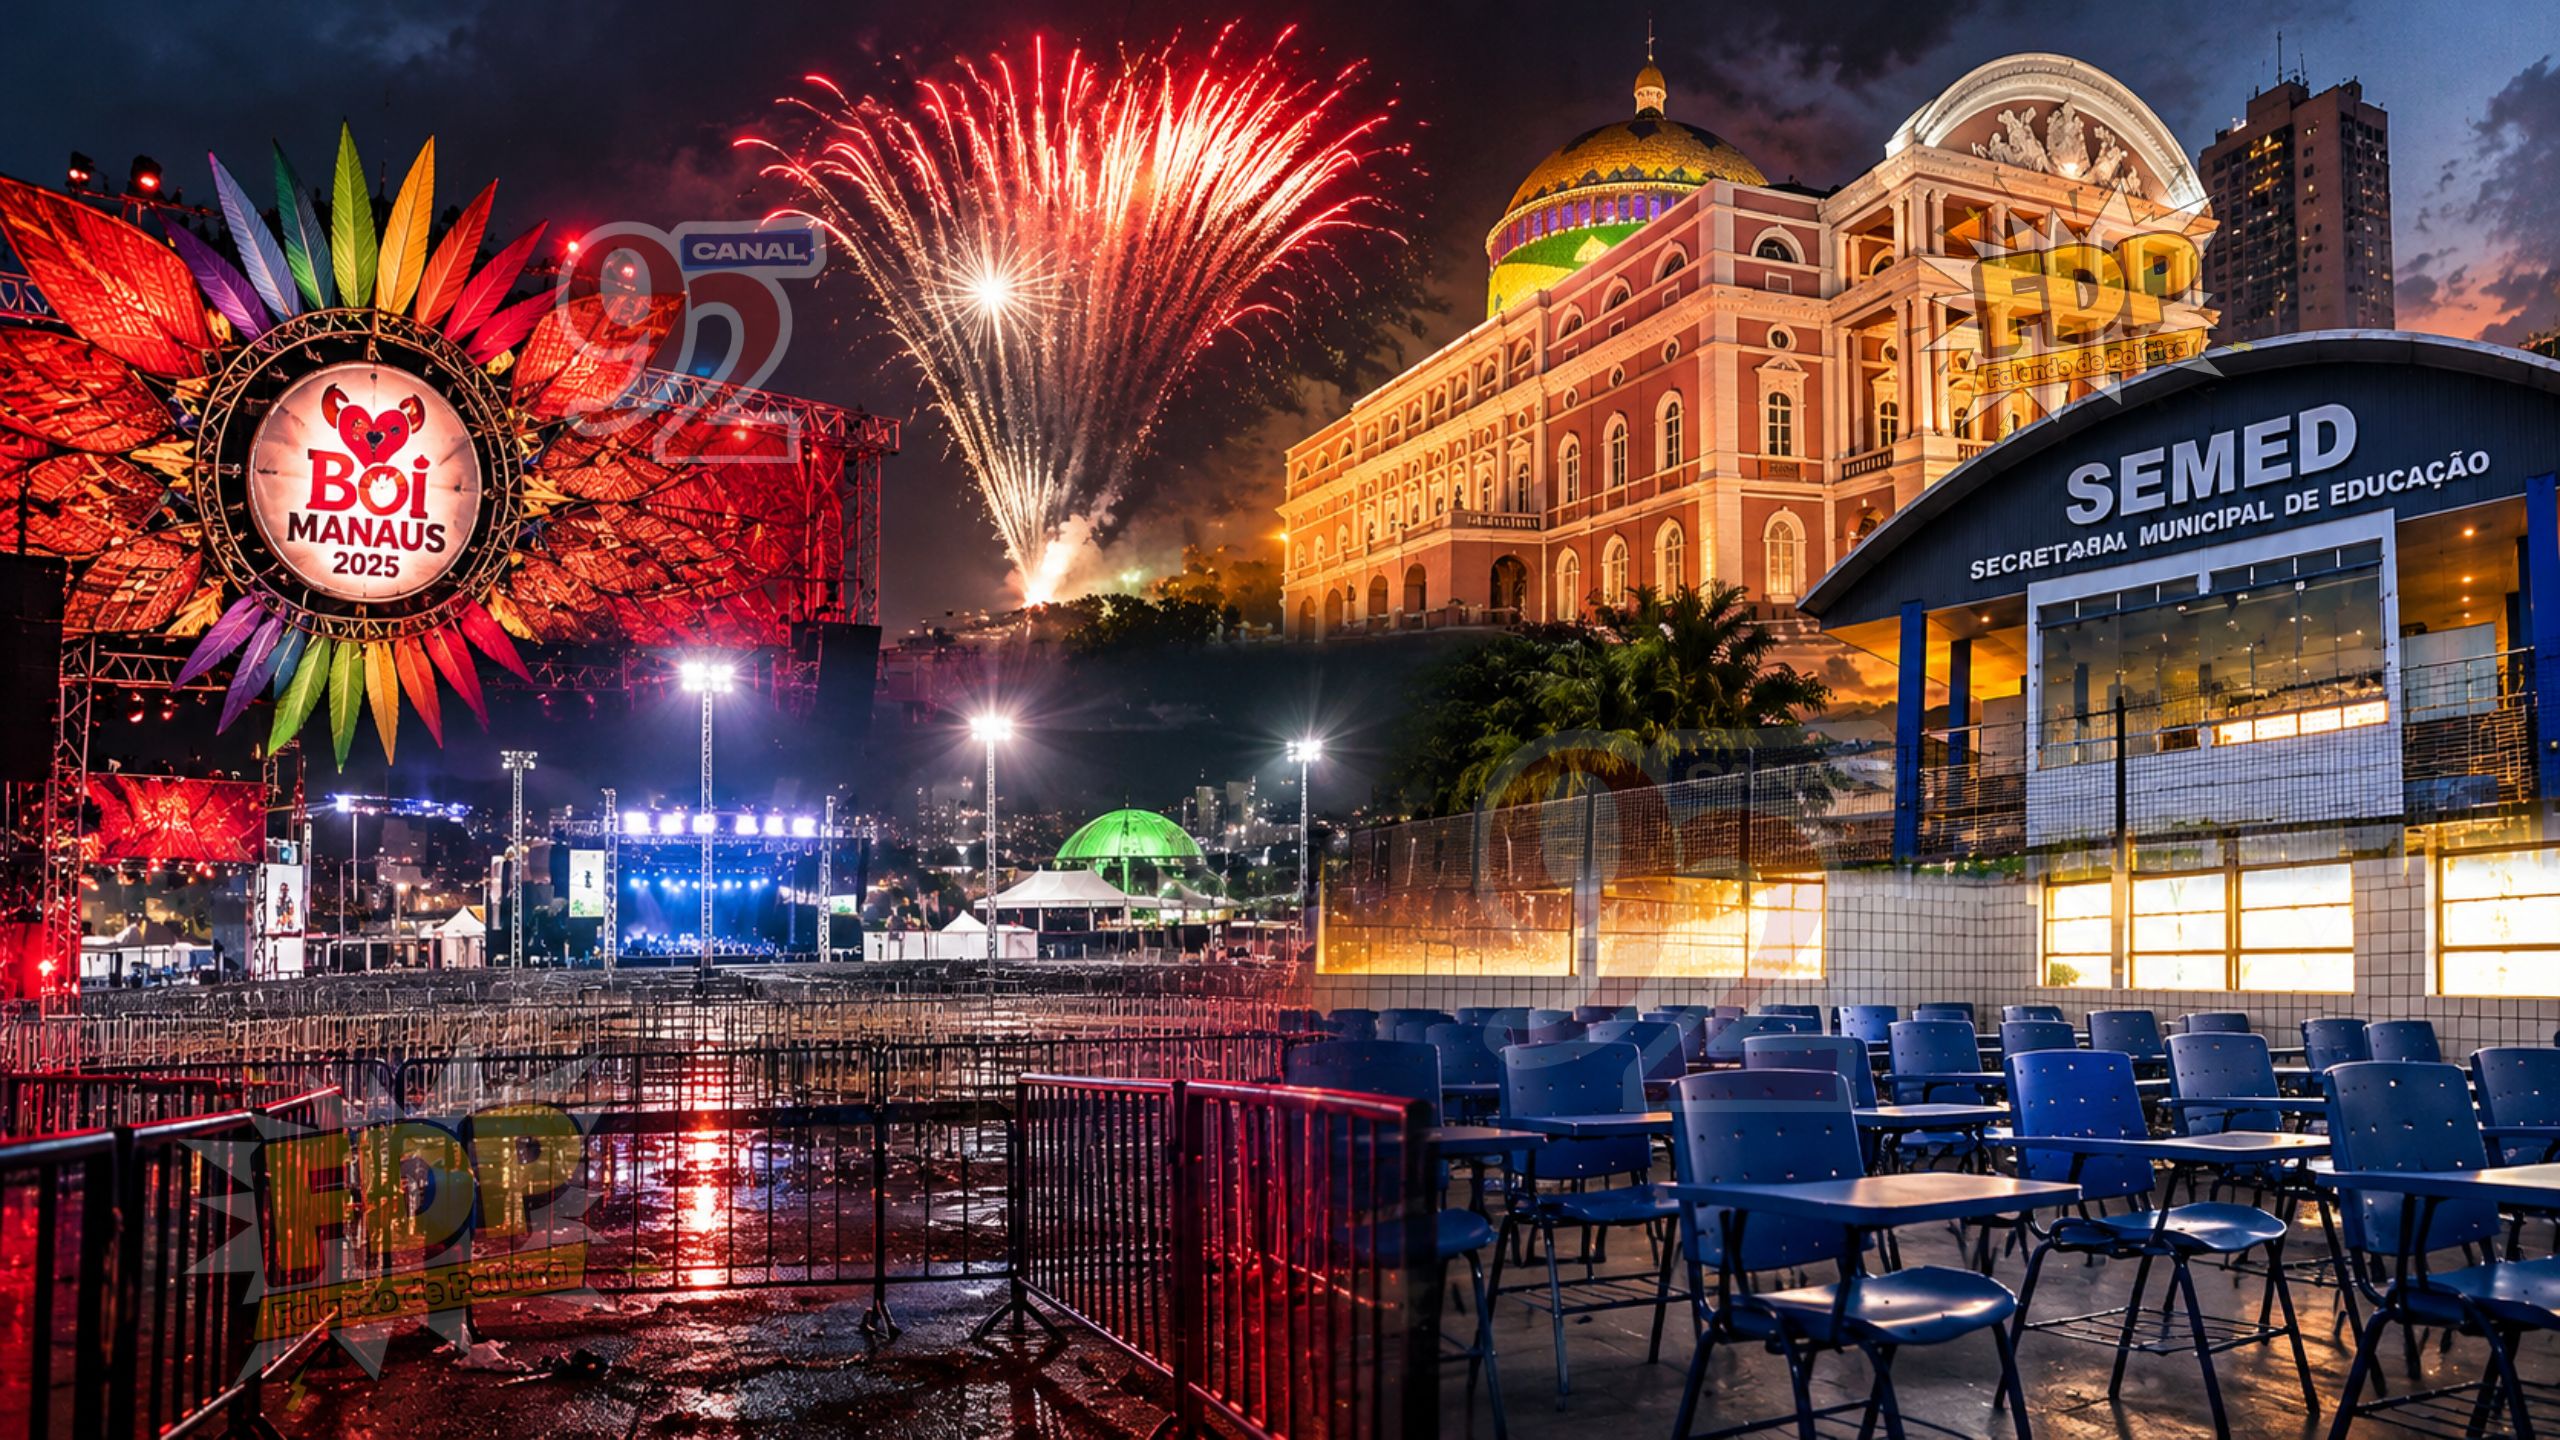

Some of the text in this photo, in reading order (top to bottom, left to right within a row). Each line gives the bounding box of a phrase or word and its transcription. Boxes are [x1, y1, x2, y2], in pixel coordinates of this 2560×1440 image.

[2065, 403, 2358, 526] SEMED
[2139, 499, 2275, 547] MUNICIPAL
[2285, 488, 2320, 516] DE
[2330, 450, 2491, 506] EDUCAÇÃO
[287, 511, 447, 553] MANAUS
[332, 551, 401, 578] 2025
